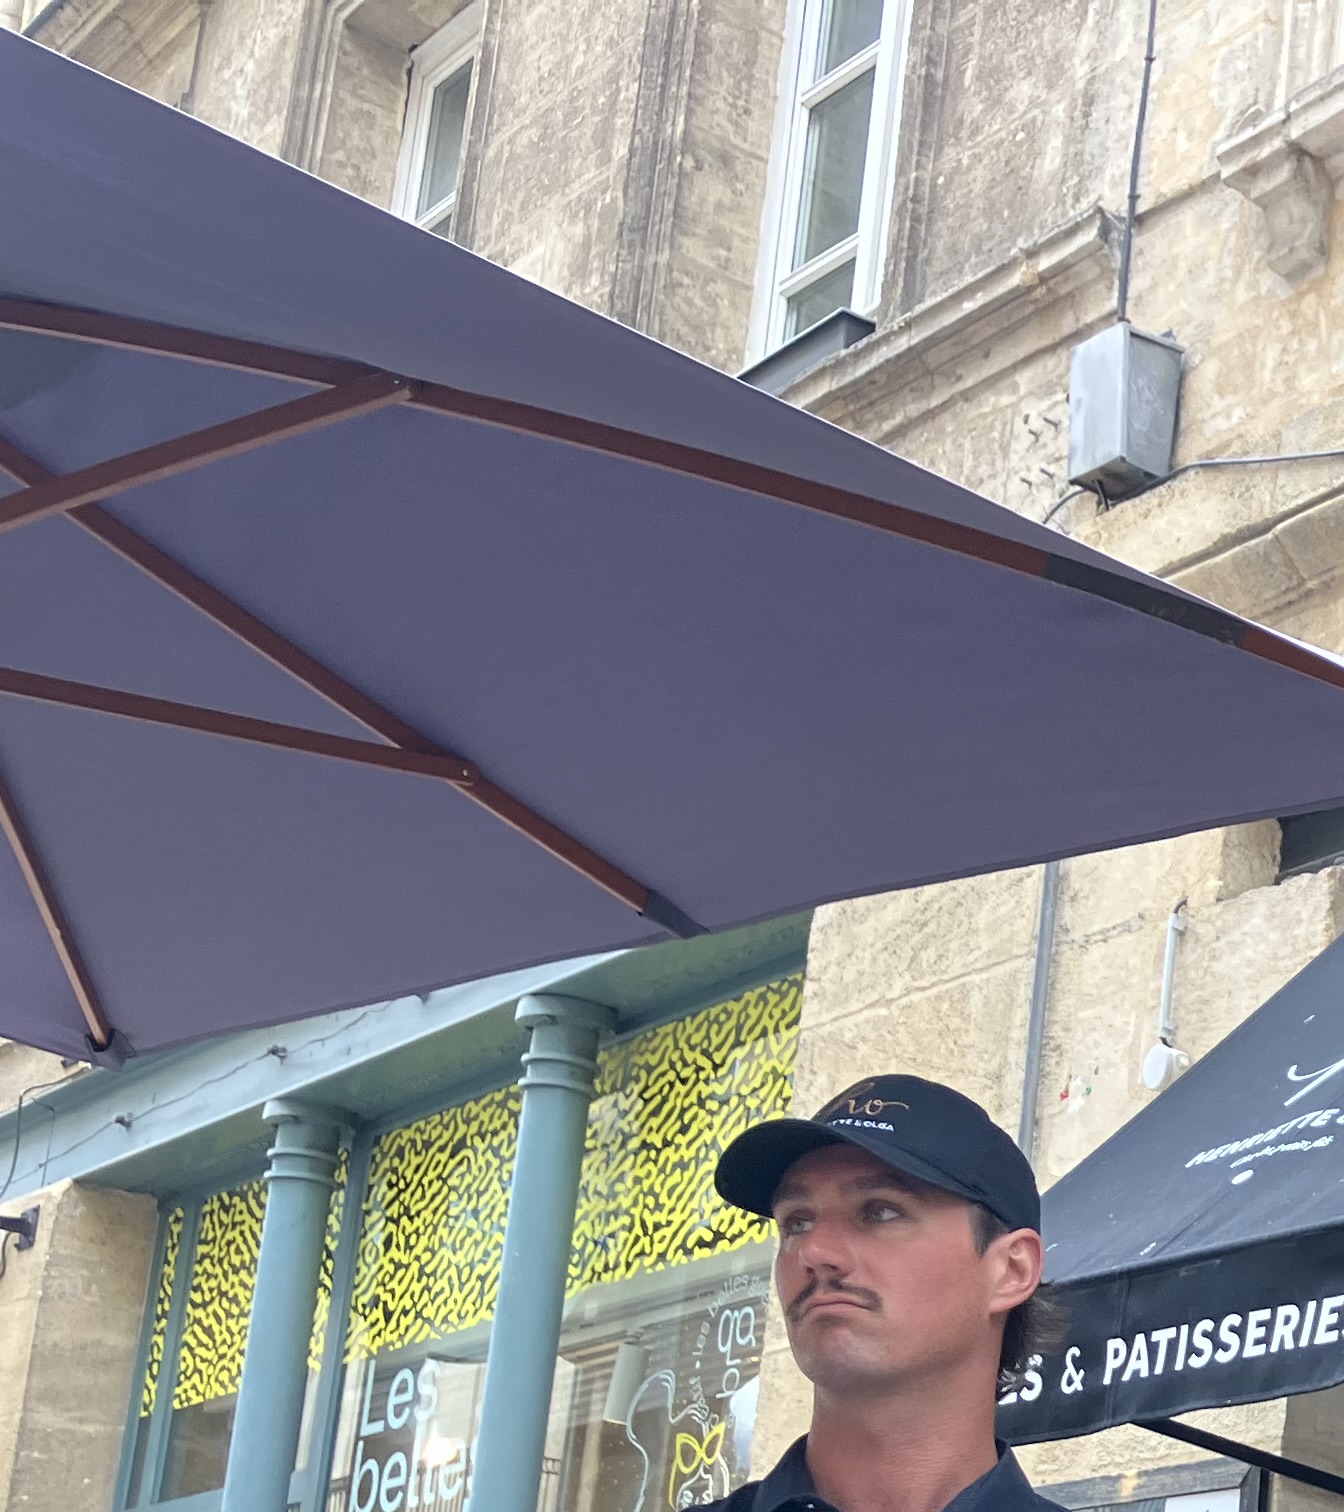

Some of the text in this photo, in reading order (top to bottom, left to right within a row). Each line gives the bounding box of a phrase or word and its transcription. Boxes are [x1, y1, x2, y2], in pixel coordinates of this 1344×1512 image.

[863, 1119, 895, 1132] OLGA
[1185, 1108, 1337, 1168] HENRIETTE
[1060, 1346, 1085, 1395] &
[360, 1358, 441, 1438] Les
